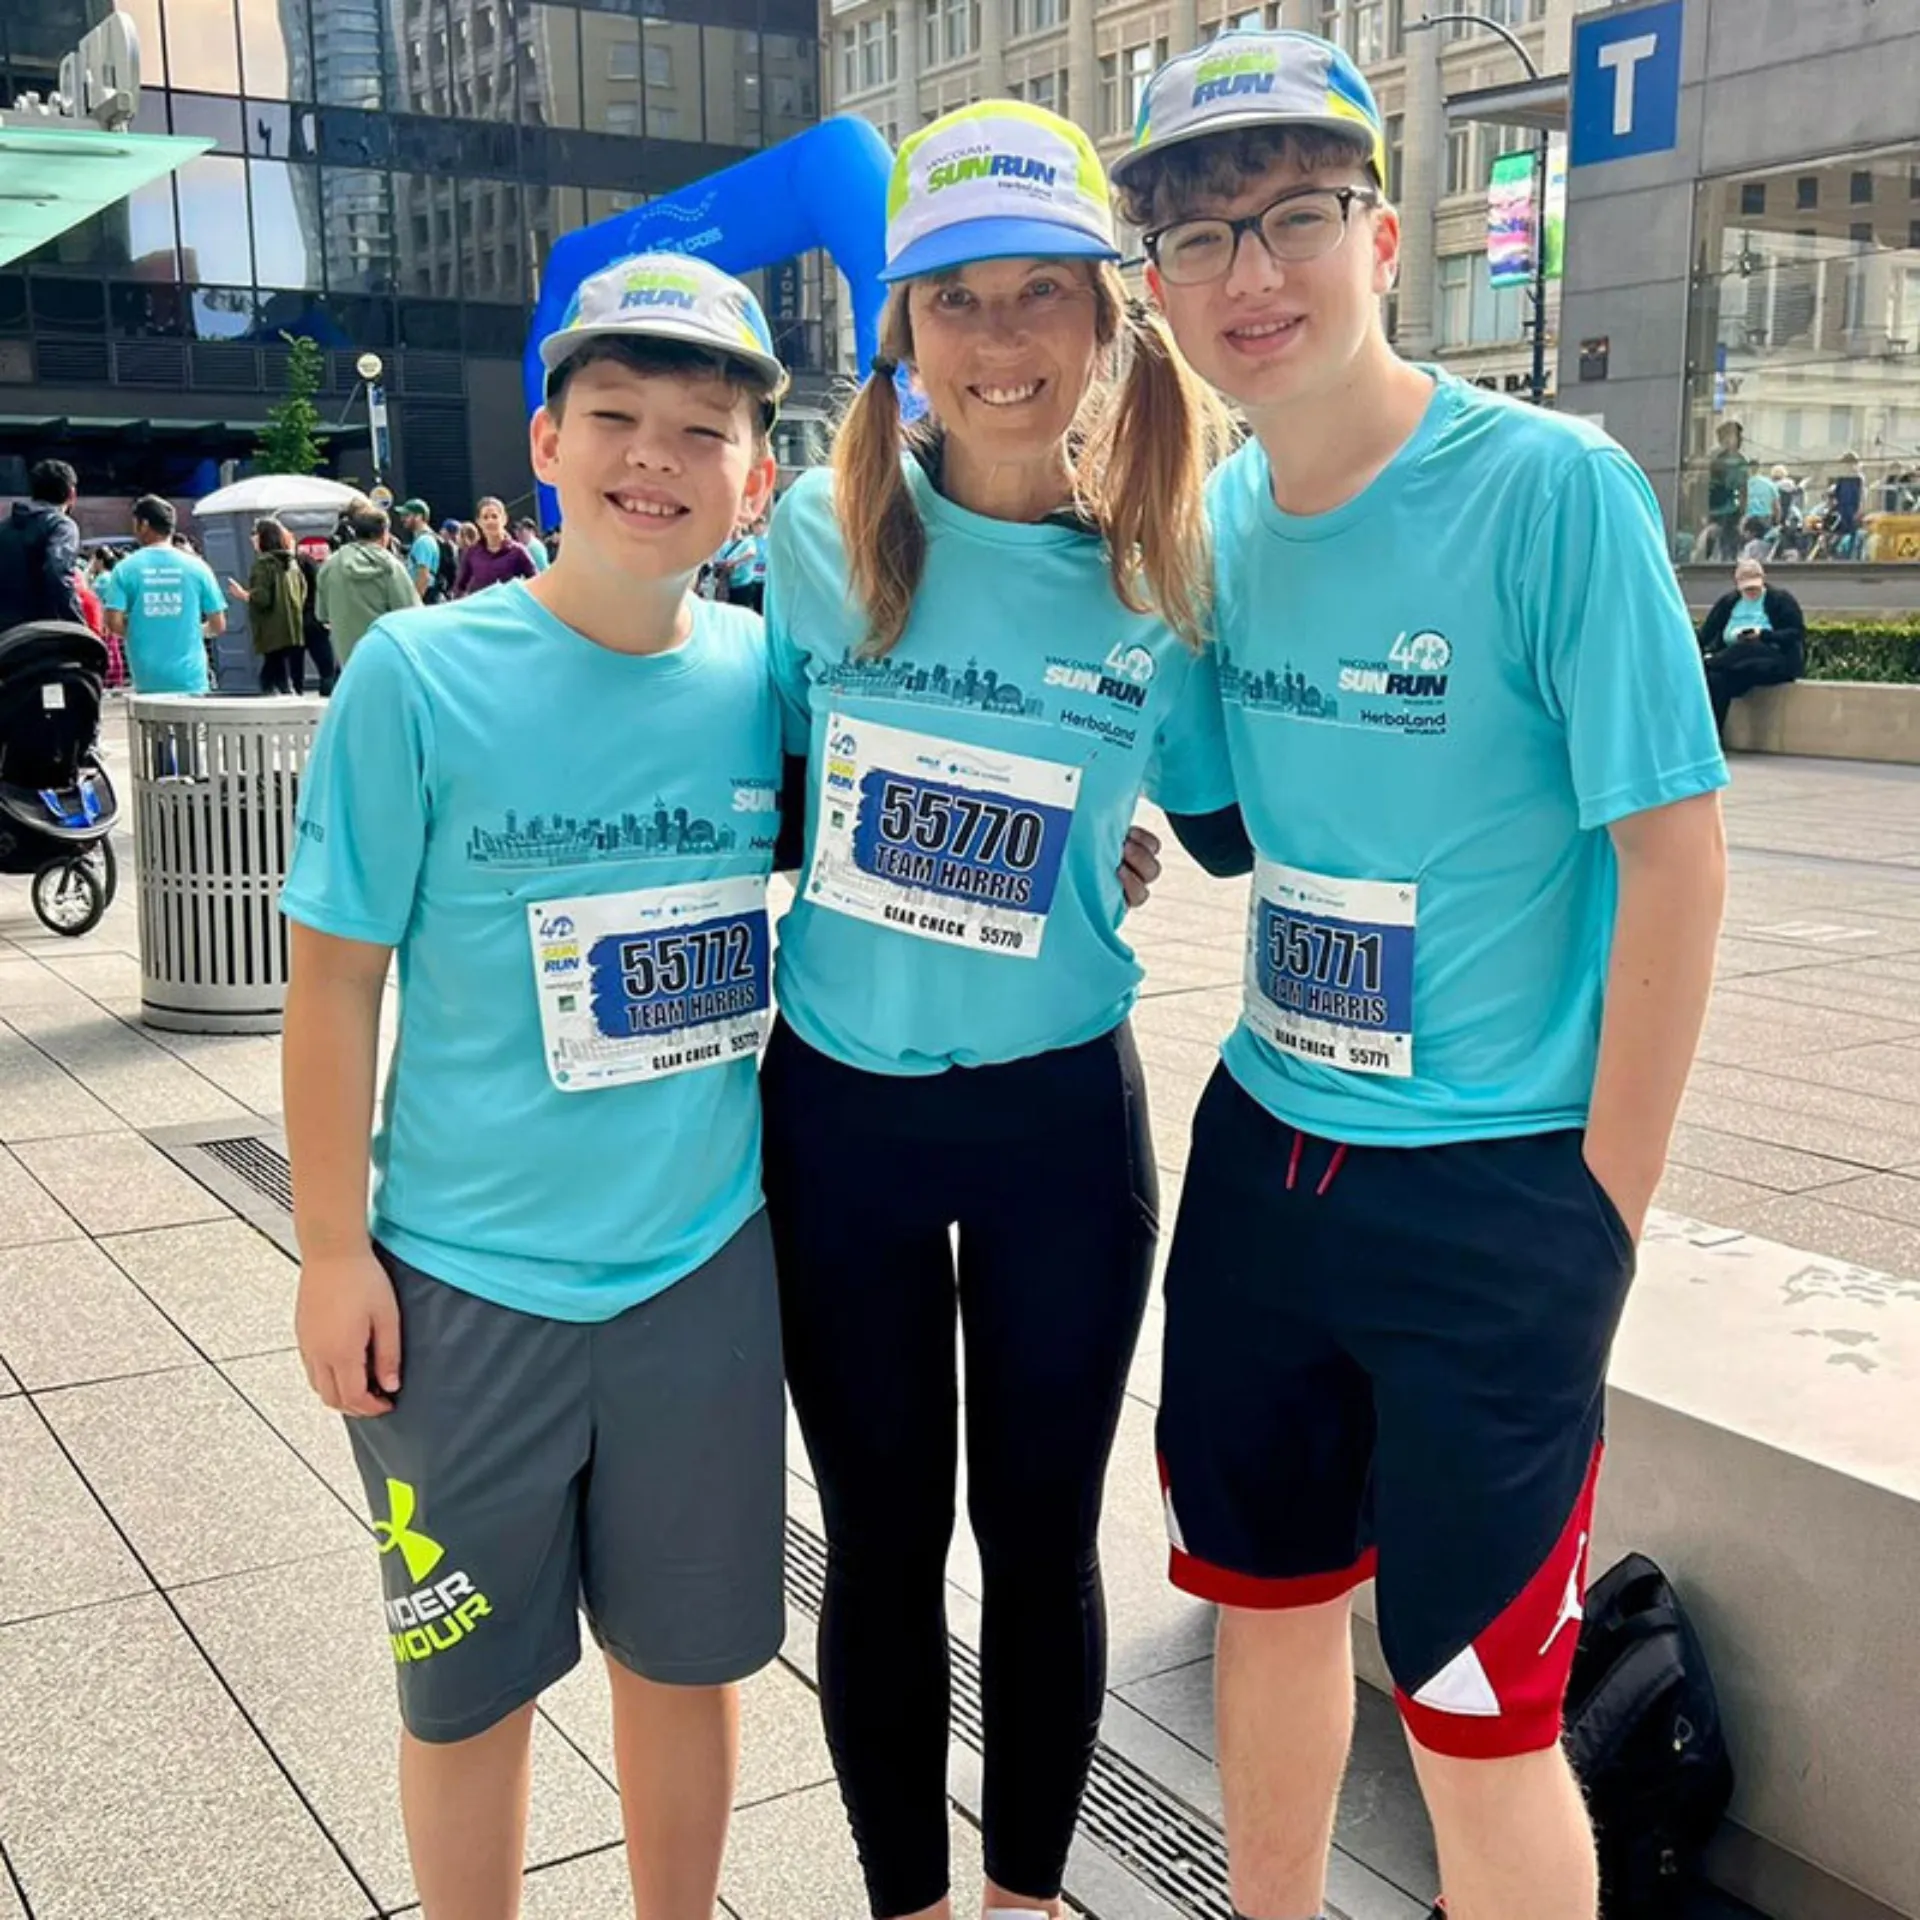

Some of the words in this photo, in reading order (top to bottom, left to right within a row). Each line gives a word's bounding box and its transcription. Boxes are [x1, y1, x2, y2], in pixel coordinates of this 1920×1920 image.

[1192, 72, 1275, 108] RUN
[1598, 32, 1657, 135] T
[619, 289, 694, 310] RUN
[1043, 664, 1147, 707] SUNRUN
[1338, 666, 1448, 696] SUNRUN
[878, 779, 1045, 871] 55770
[875, 843, 935, 884] TEAM
[938, 859, 1032, 904] HARRIS
[545, 957, 579, 973] RUN
[620, 922, 753, 999] 55772
[1267, 910, 1382, 993] 55771
[627, 998, 688, 1032] TEAM
[690, 982, 756, 1020] HARRIS
[1307, 983, 1387, 1026] HARRIS
[1349, 1047, 1390, 1068] 55771
